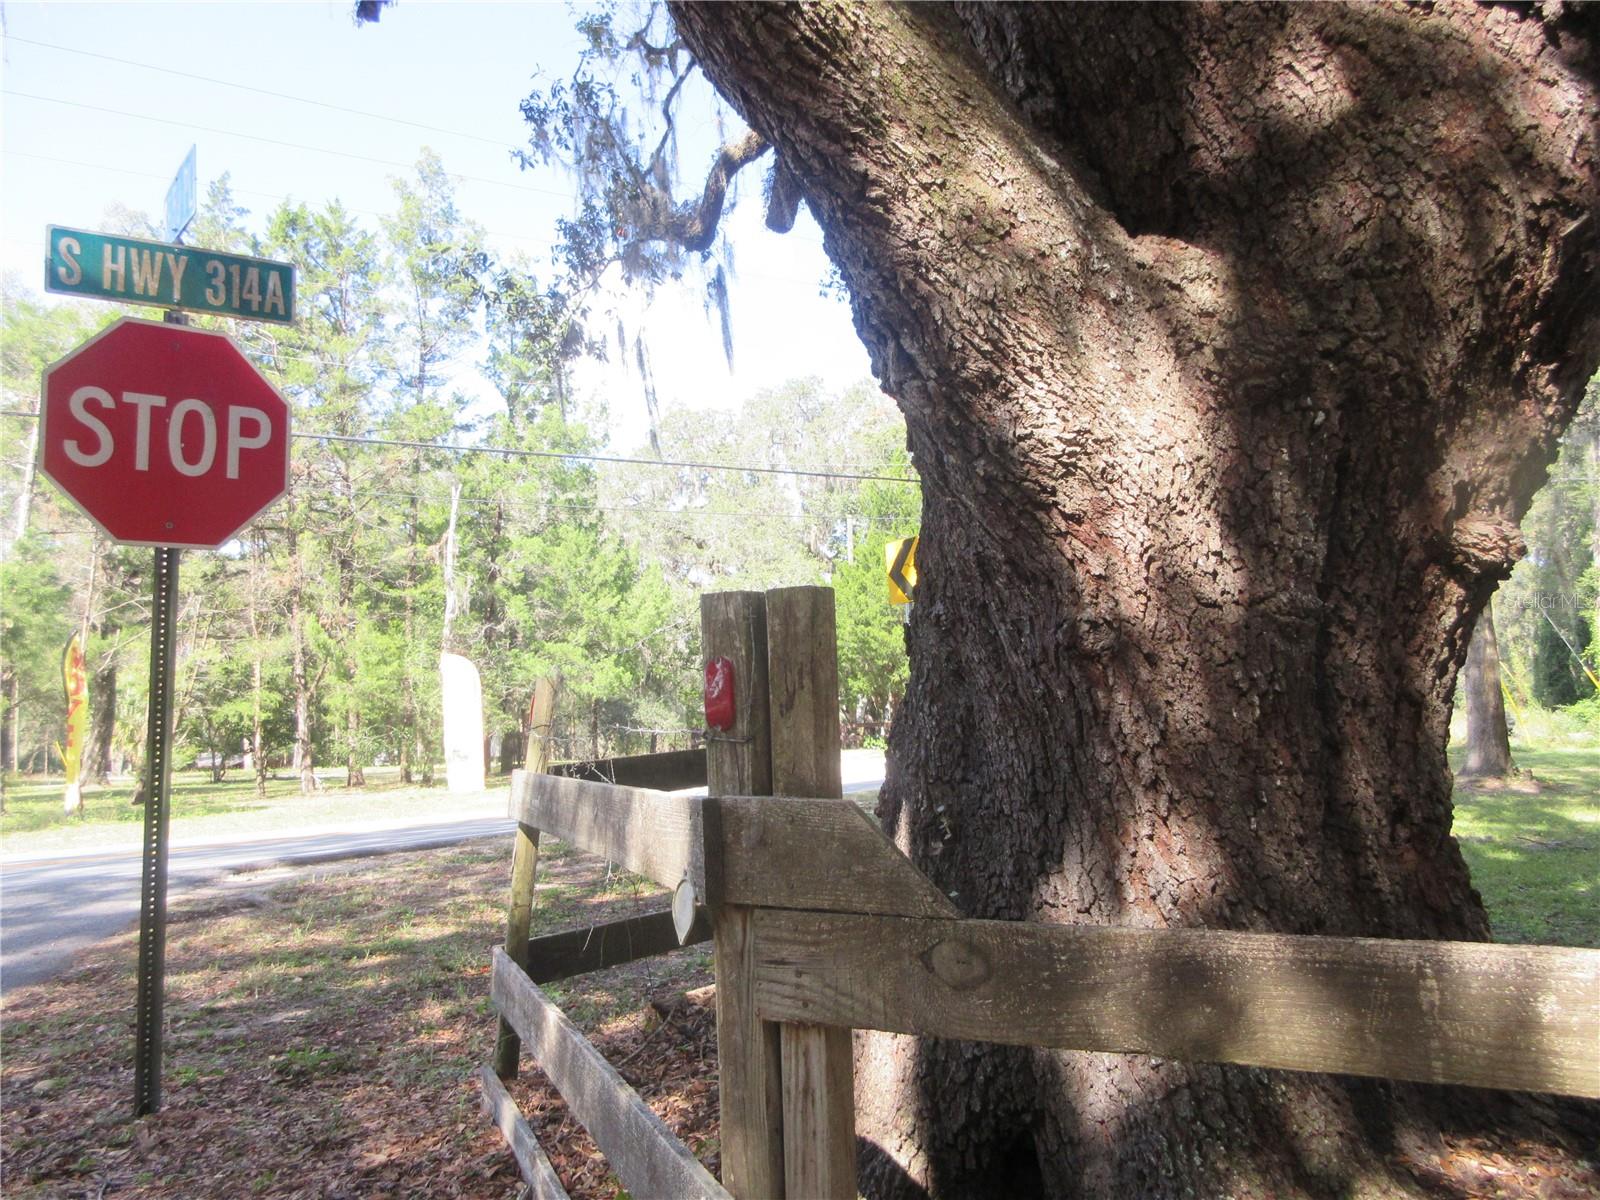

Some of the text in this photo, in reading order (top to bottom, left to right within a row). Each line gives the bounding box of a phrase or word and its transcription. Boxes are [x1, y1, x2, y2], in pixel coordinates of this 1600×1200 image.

[58, 237, 285, 315] S HWY 314A
[64, 386, 272, 480] STOP
